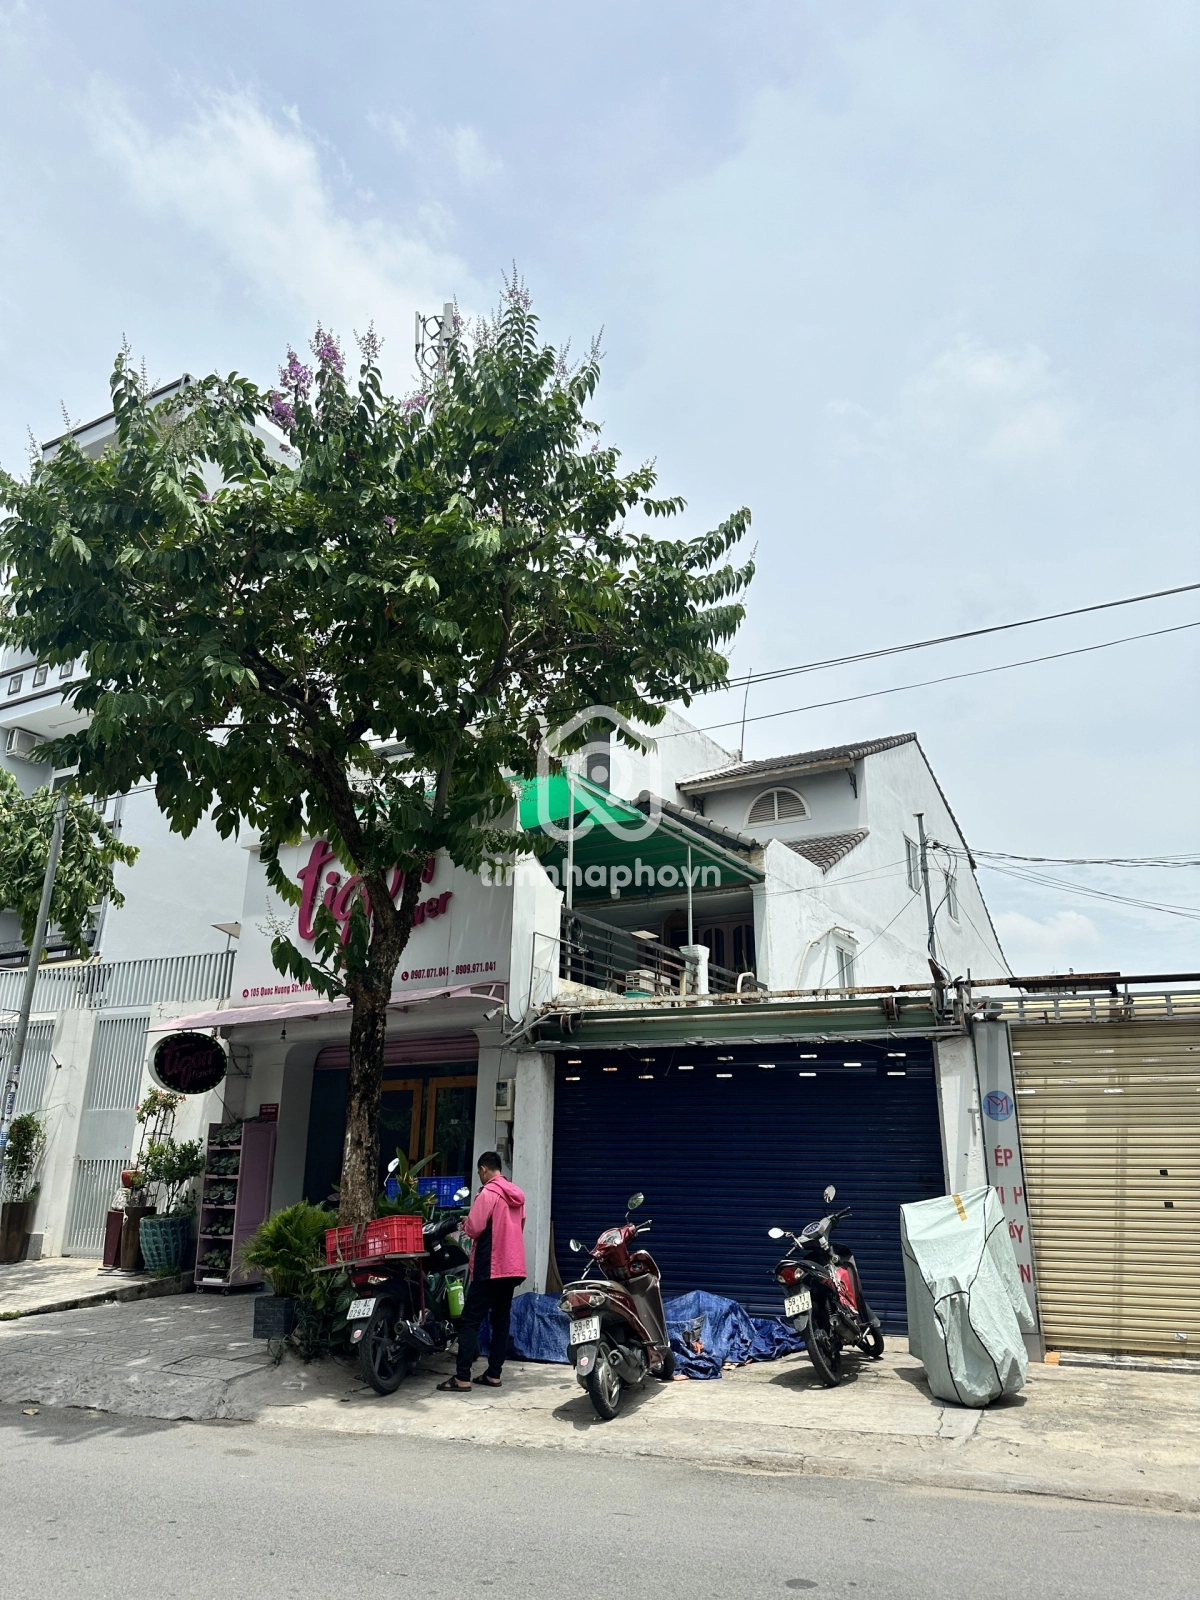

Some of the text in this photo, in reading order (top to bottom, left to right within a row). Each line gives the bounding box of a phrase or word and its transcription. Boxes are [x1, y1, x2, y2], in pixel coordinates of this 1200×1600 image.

[411, 966, 449, 979] 0907.071.041
[455, 961, 496, 975] 0909.971.041
[994, 1144, 1013, 1166] ÉP
